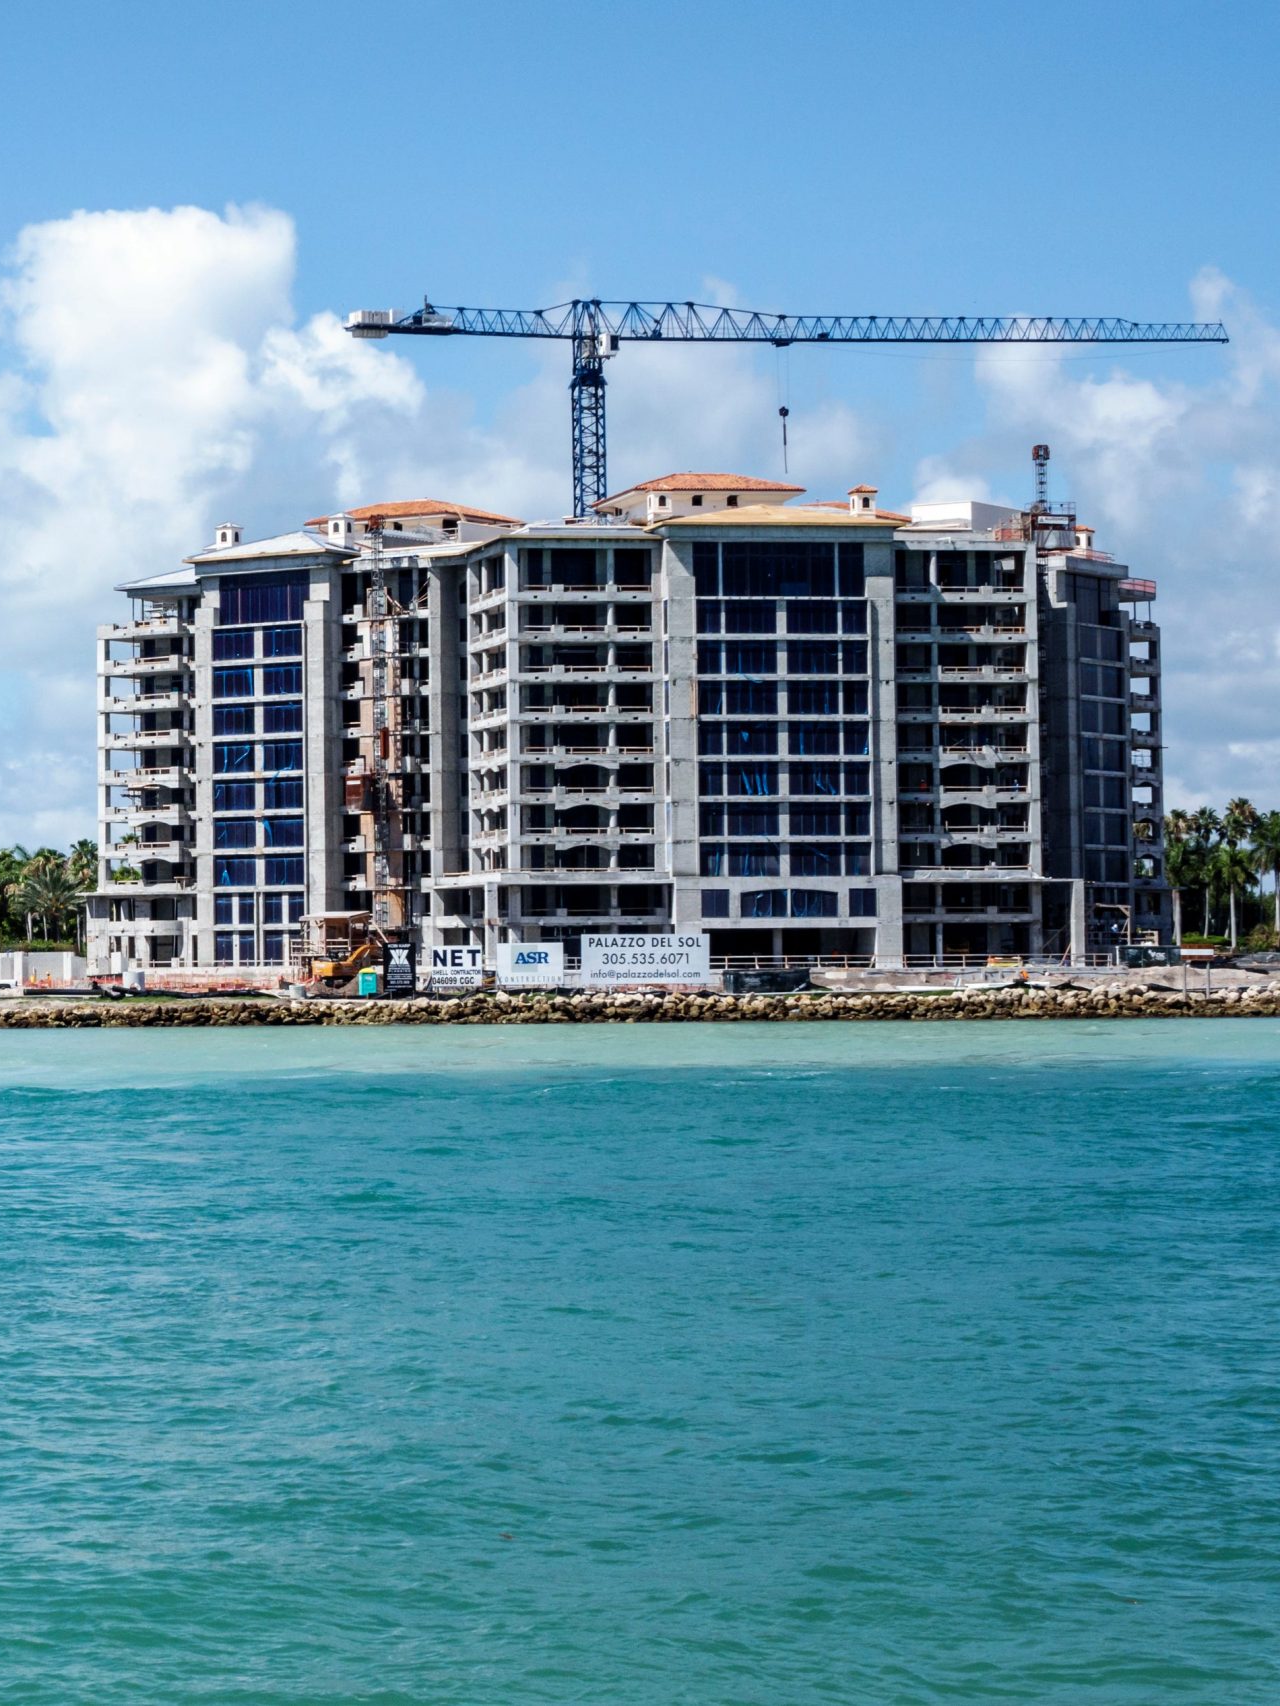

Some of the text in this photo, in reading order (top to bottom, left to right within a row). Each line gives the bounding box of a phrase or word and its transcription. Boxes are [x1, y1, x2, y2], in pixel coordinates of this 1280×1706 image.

[588, 937, 702, 948] PALAZZO DEL SOL
[433, 949, 481, 967] NET
[515, 951, 549, 964] ASR
[602, 953, 690, 965] 305.535.6071
[500, 975, 562, 983] CONSTRUCTION
[590, 968, 701, 980] info@palazzodelsol.com
[432, 976, 475, 985] 046099 CGC
